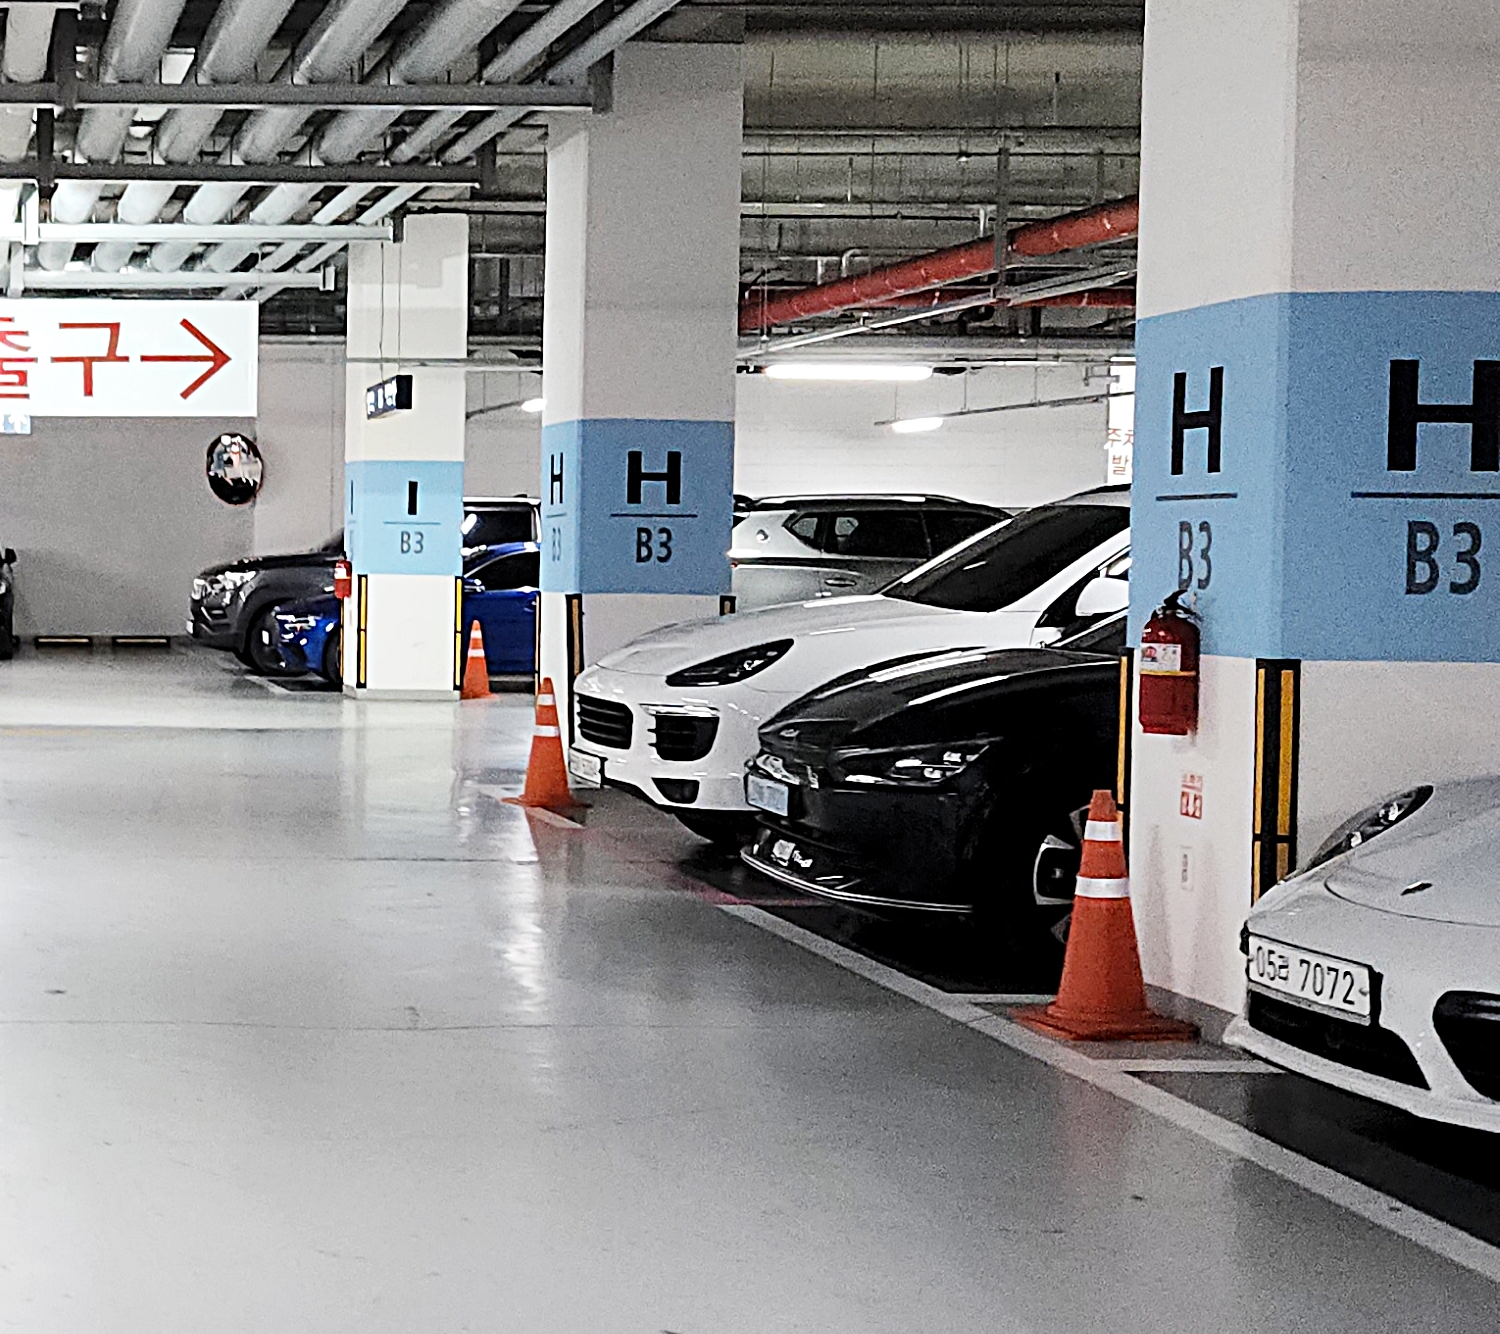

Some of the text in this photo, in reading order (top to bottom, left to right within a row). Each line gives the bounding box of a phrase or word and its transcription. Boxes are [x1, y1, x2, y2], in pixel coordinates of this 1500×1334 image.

[1171, 366, 1224, 475] H
[1387, 358, 1500, 472] H
[407, 480, 419, 516] I
[550, 452, 564, 505] H
[627, 451, 681, 505] H
[400, 531, 424, 555] B3
[635, 527, 673, 564] B3
[1178, 520, 1213, 591] B3
[1405, 520, 1483, 596] B3
[1299, 958, 1356, 1006] 7072
